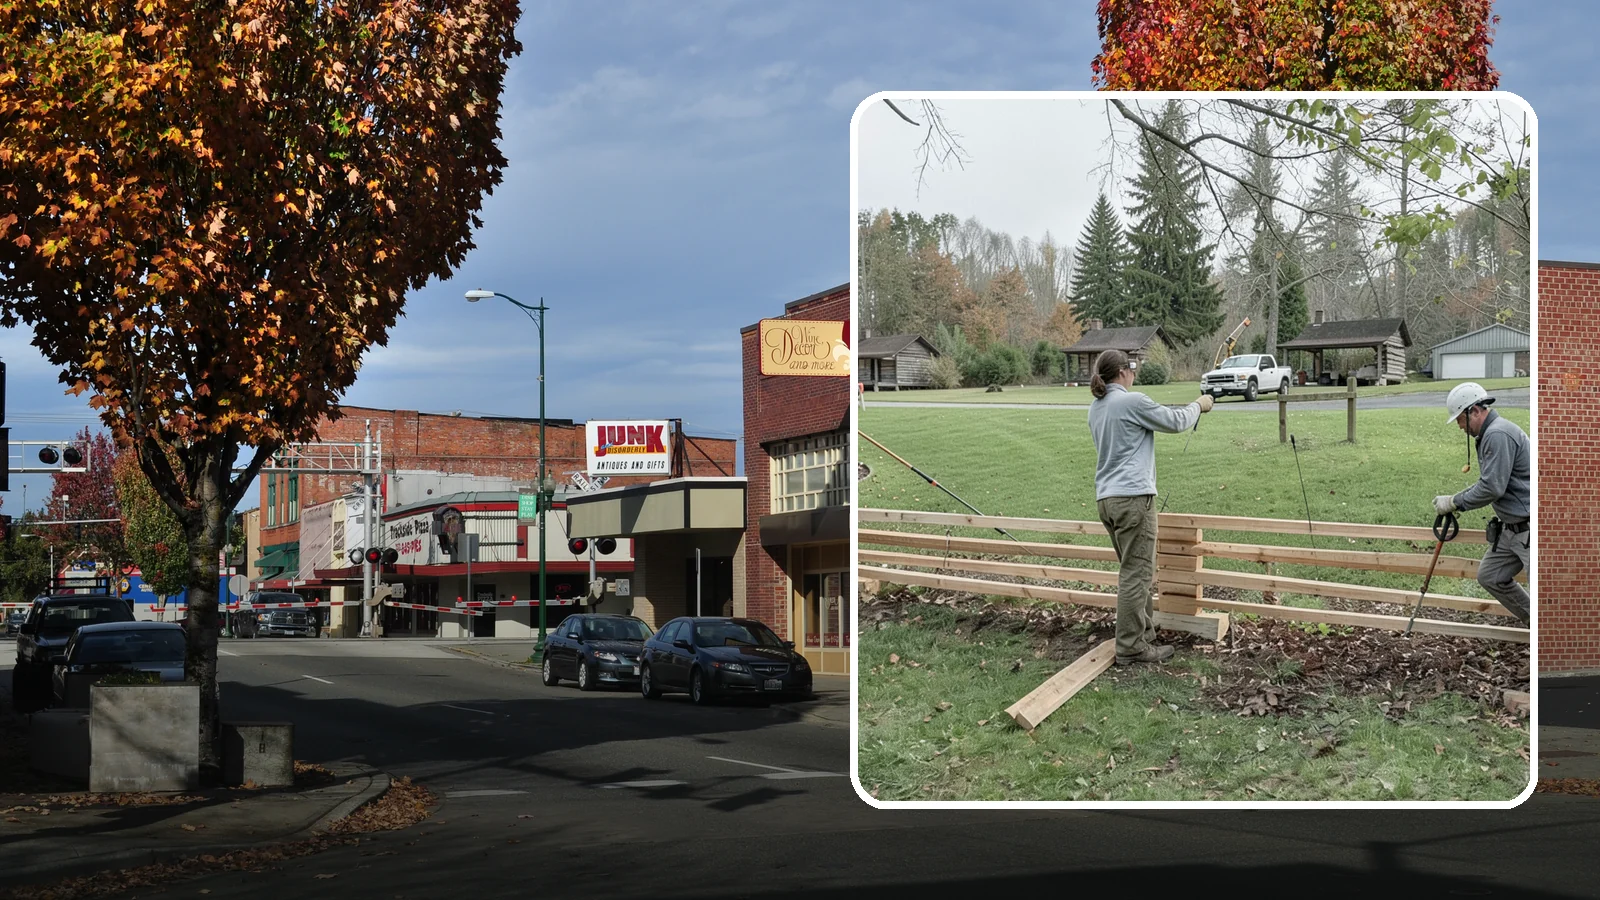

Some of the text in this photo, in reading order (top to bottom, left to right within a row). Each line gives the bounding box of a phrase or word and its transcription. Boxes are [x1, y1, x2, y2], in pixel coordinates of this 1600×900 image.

[595, 425, 665, 457] JUNK
[597, 460, 665, 470] ANTIQUES AND GIFTS
[573, 473, 588, 492] RAIL
[352, 498, 365, 511] CRO
[414, 520, 429, 535] Pizza
